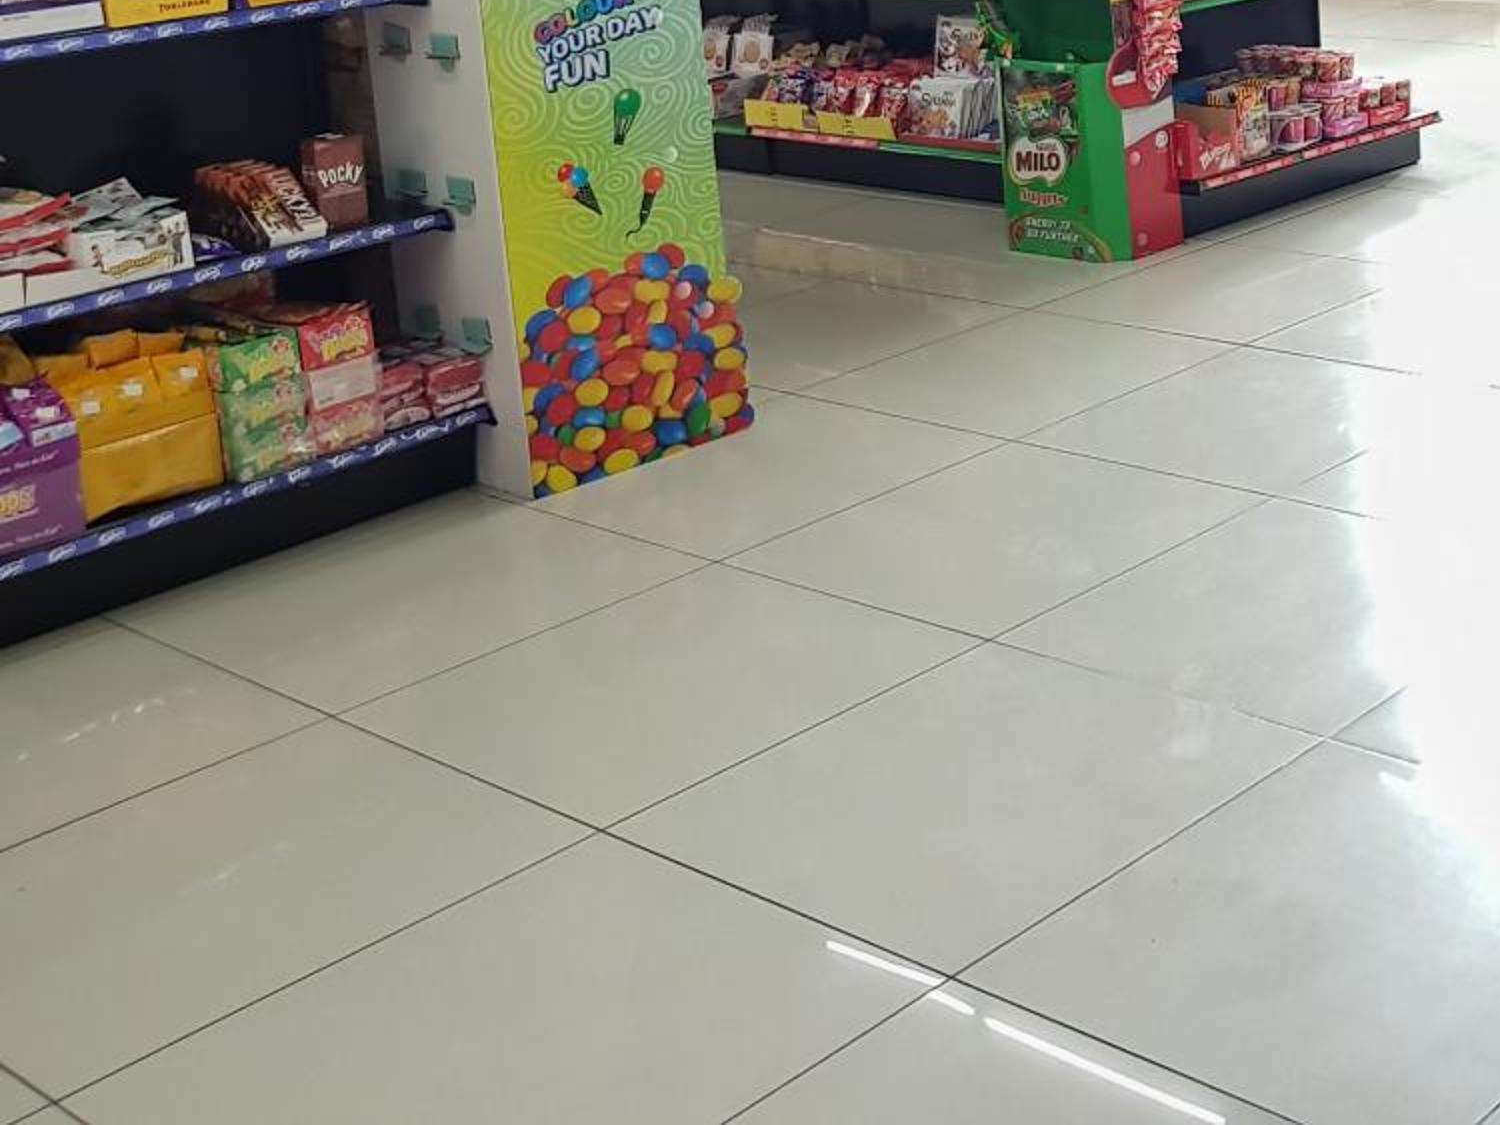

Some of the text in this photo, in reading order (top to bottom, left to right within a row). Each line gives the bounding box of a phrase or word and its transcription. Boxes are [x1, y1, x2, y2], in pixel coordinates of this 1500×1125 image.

[536, 24, 606, 66] YOUR
[544, 49, 610, 93] FUN
[317, 161, 364, 188] POCKY
[1015, 151, 1061, 172] MILO
